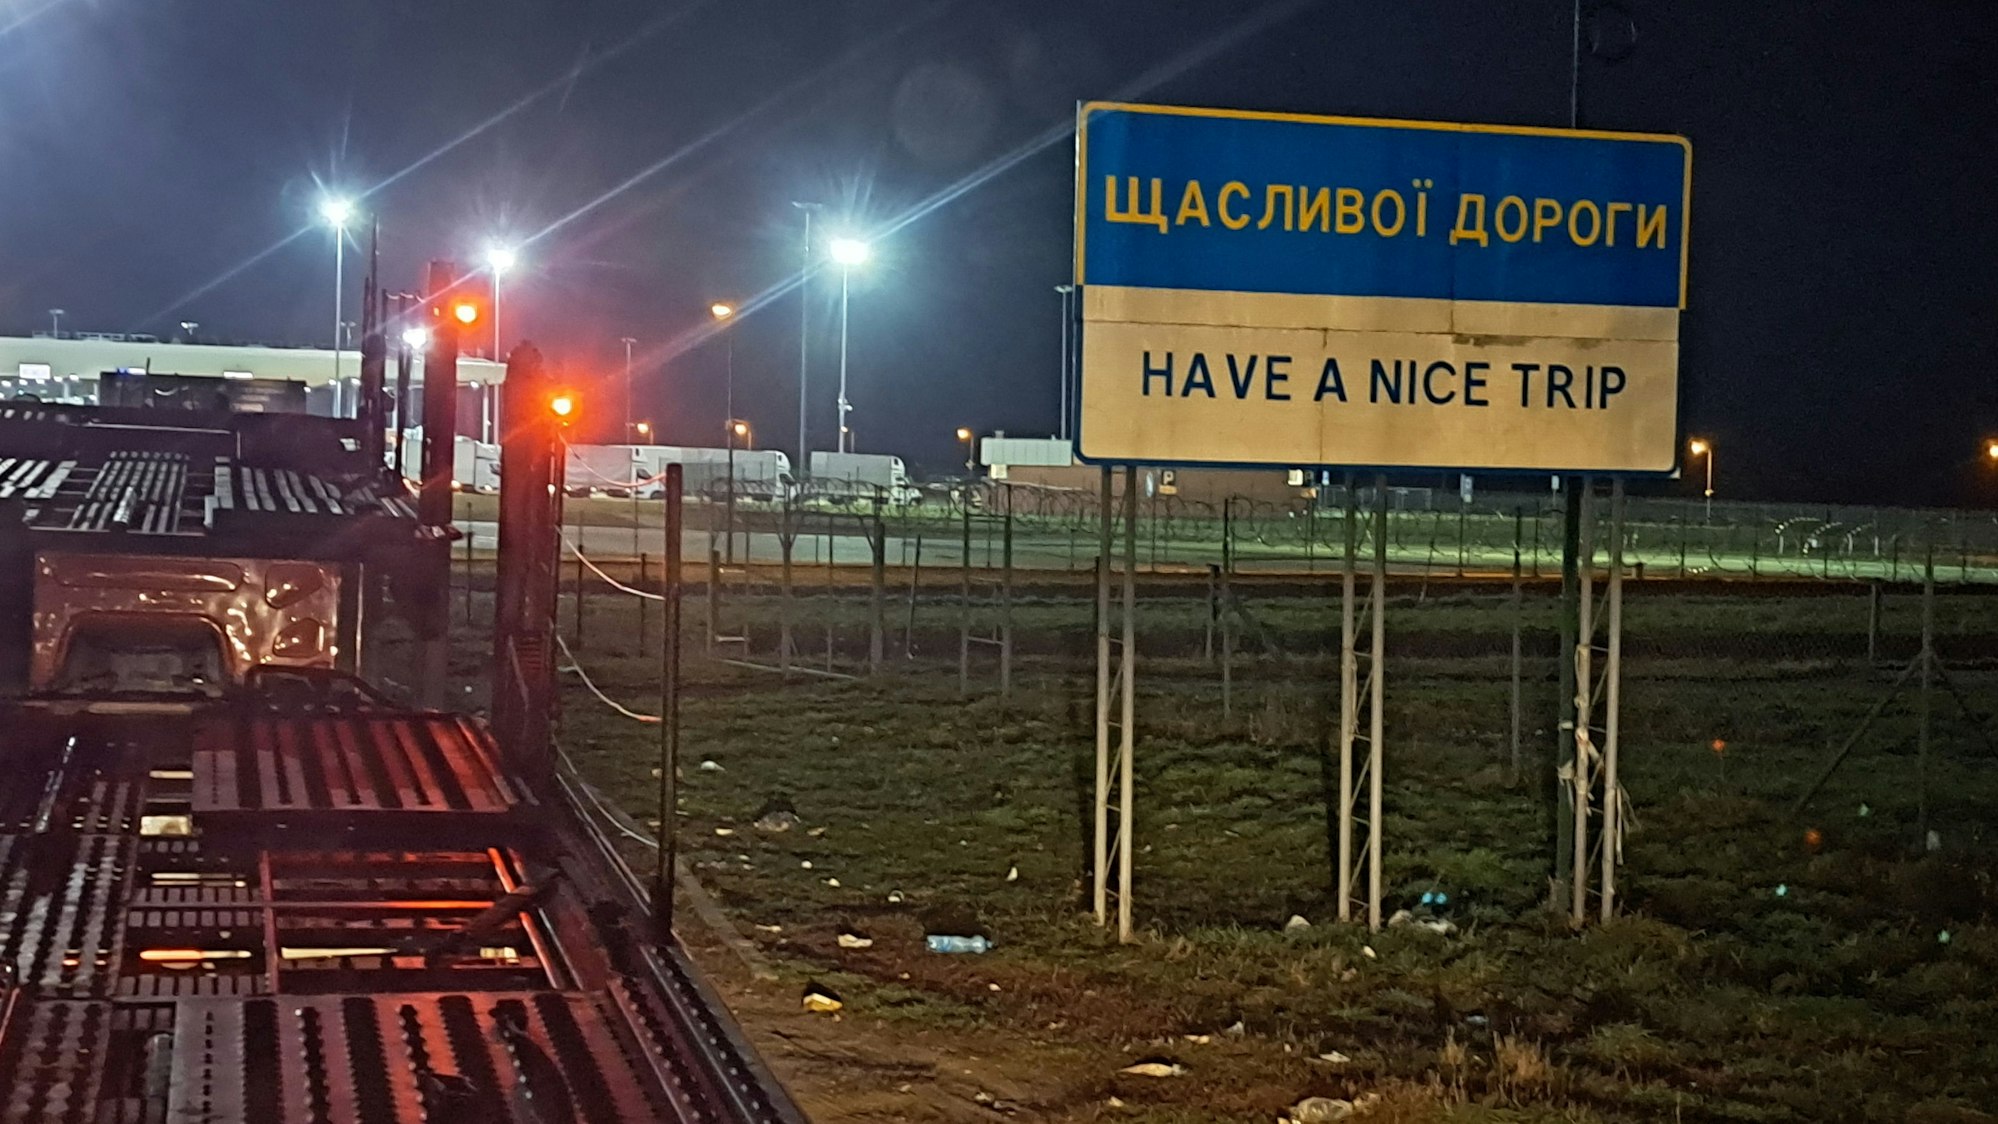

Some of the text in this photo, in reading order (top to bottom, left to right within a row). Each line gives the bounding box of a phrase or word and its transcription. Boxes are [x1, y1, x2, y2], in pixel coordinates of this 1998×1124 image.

[1105, 174, 1669, 249] ЩАСЛИВОЇ ДОРОГИ
[1142, 350, 1628, 410] HAVE A NICE TRIP
